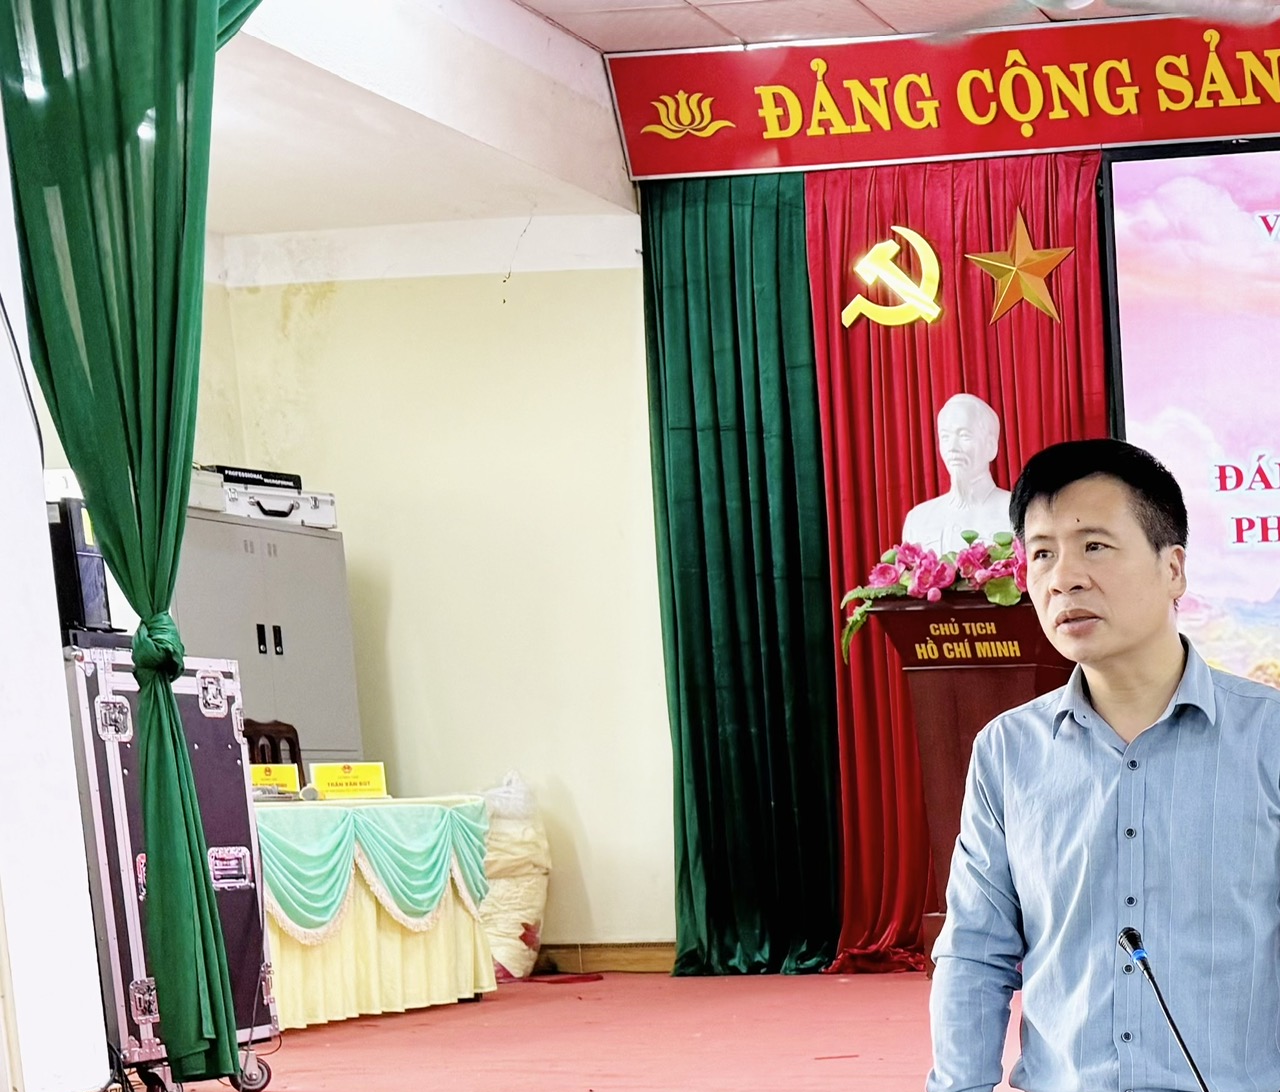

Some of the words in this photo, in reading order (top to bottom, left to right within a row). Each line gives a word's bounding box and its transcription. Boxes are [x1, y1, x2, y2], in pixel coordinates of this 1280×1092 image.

[755, 59, 939, 139] ĐẢNG
[957, 50, 1139, 137] CỘNG
[929, 618, 959, 635] CHỦ
[962, 622, 997, 636] TỊCH
[915, 637, 939, 659] HỒ
[942, 638, 972, 658] CHÍ
[975, 641, 1021, 658] MINH
